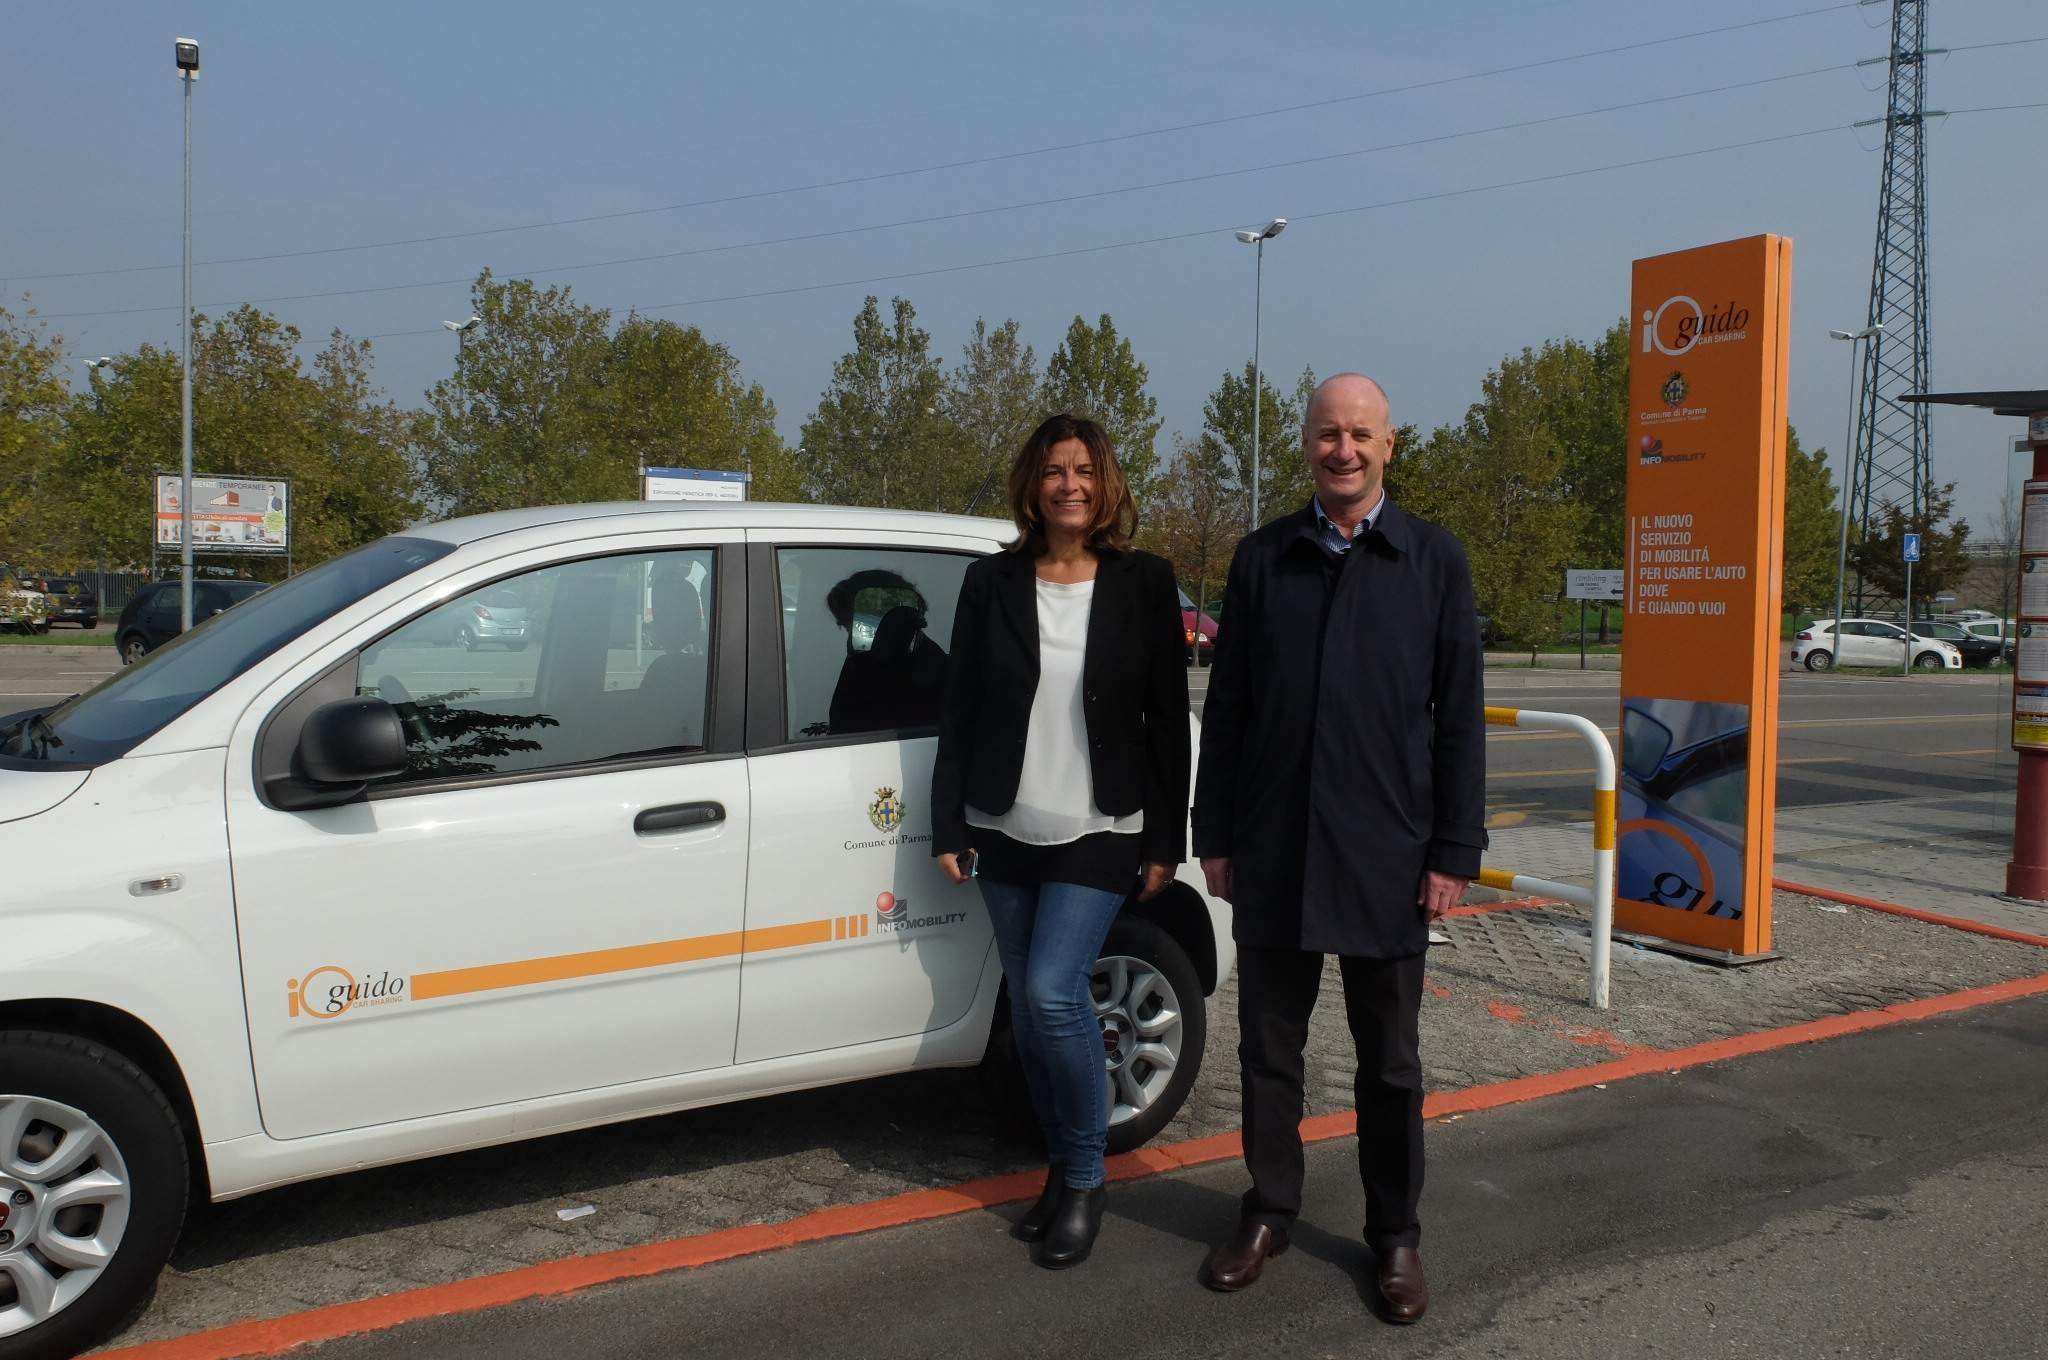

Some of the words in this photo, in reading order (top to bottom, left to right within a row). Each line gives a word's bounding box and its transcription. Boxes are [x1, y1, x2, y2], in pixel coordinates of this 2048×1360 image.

[1674, 301, 1749, 349] guido
[1698, 334, 1713, 345] CAR
[1714, 331, 1747, 343] SHARING
[1641, 411, 1672, 420] Comune
[1673, 409, 1680, 417] di
[1682, 407, 1707, 416] Parma
[1641, 515, 1651, 529] IL
[1654, 514, 1693, 528] NUOVO
[1640, 532, 1691, 546] SERVIZIO
[1640, 550, 1651, 563] DI
[1639, 567, 1661, 580] PER
[1664, 566, 1701, 580] USARE
[1704, 565, 1746, 580] L'AUTO
[1639, 584, 1669, 597] DOVE
[1638, 602, 1647, 614] E
[1648, 601, 1696, 615] QUANDO
[1698, 601, 1726, 615] VUOI
[844, 838, 886, 851] Comune
[888, 834, 899, 846] di
[901, 834, 932, 844] Parma
[325, 971, 404, 1013] guido
[352, 1000, 369, 1009] CAR
[370, 995, 404, 1008] SHARING
